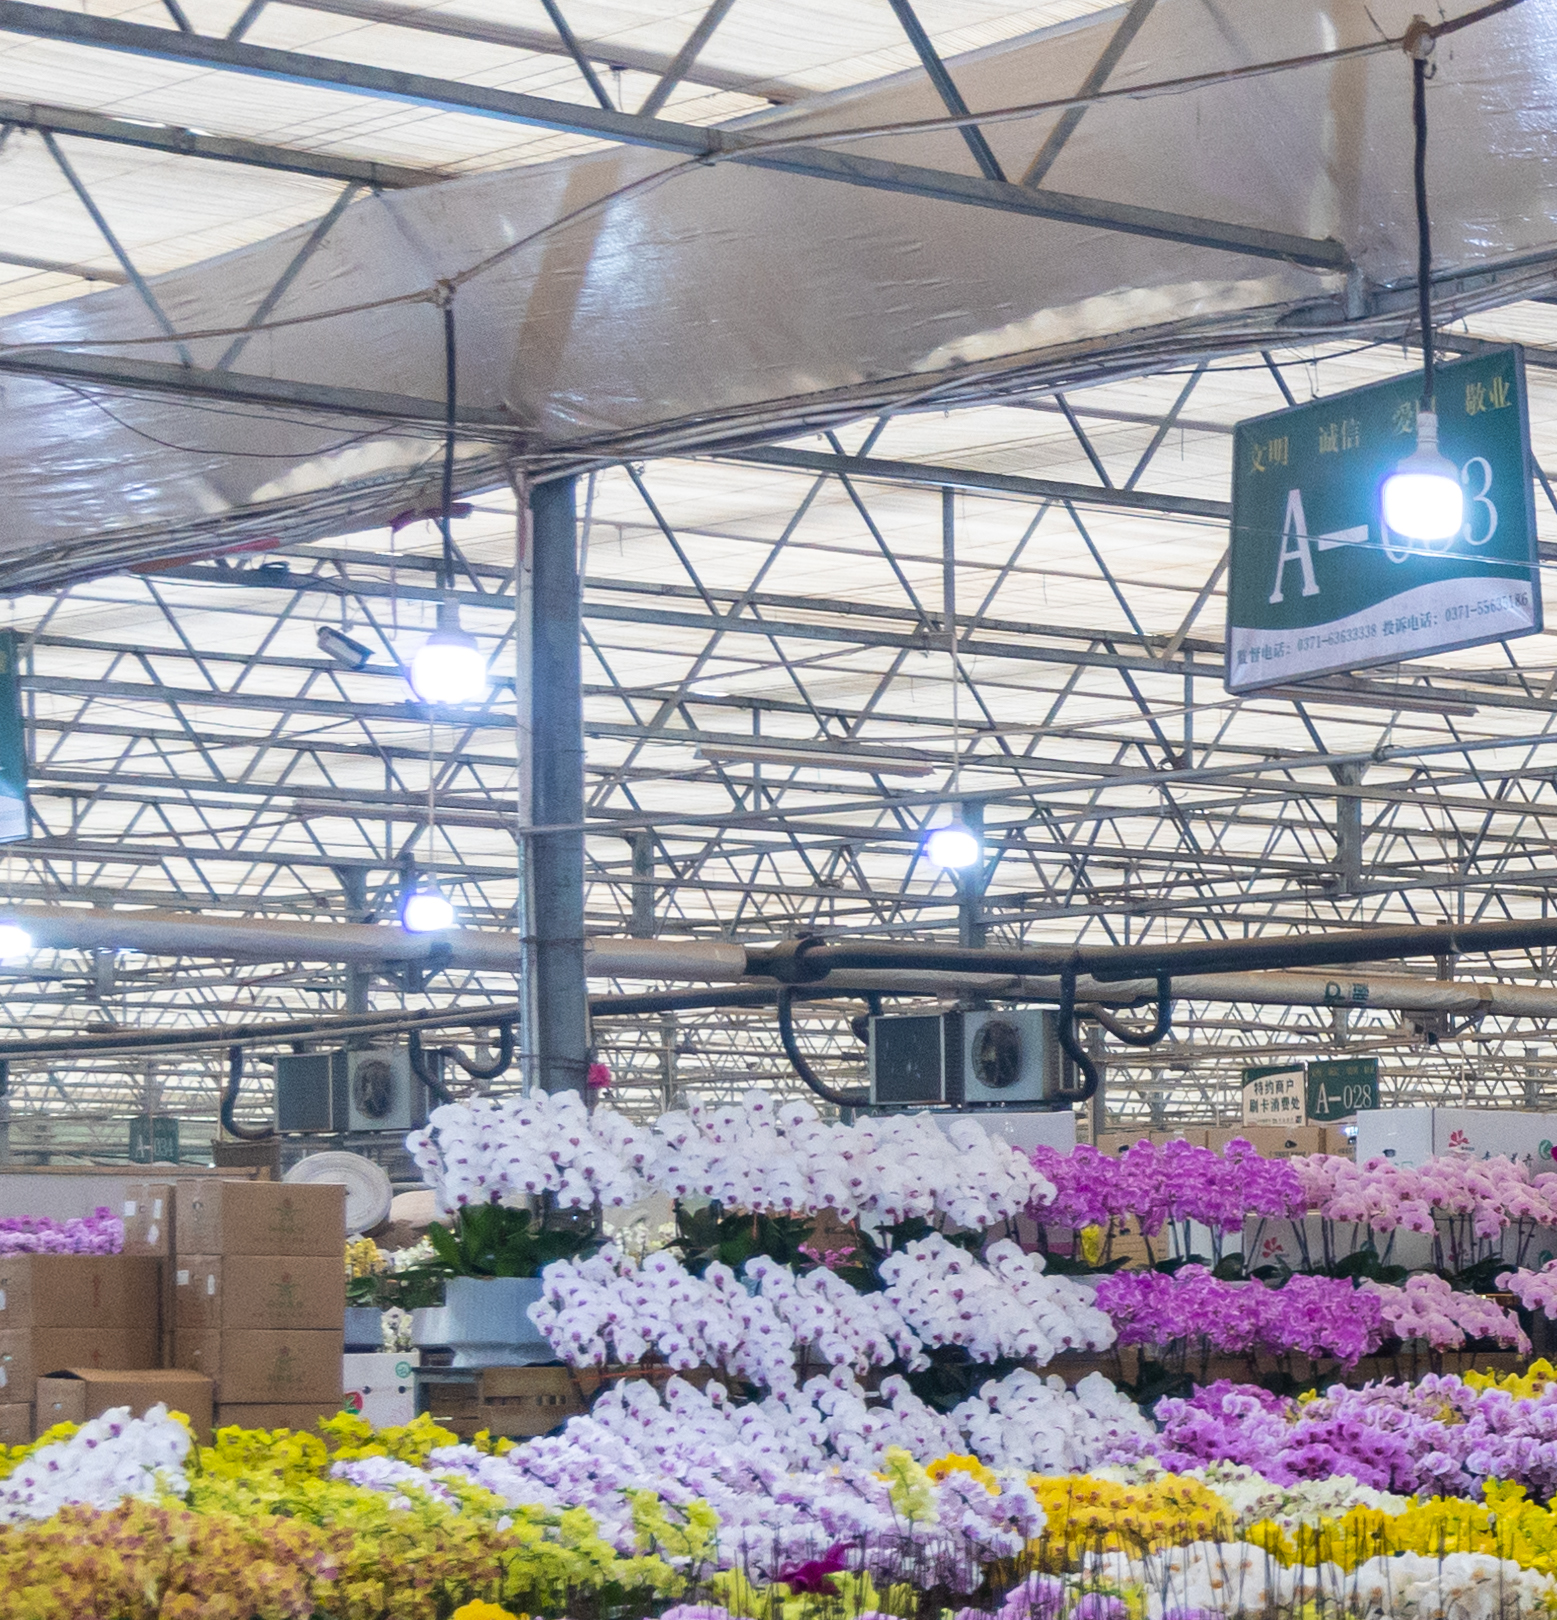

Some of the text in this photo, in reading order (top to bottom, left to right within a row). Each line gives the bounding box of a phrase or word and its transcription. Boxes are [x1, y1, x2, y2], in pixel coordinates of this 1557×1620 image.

[1250, 435, 1289, 472] 文明
[1319, 417, 1360, 454] 诚信
[1465, 375, 1512, 417] 敬业
[1269, 456, 1498, 604] A-3
[1253, 1078, 1294, 1096] 特约商户
[1315, 1082, 1372, 1114] A-028
[1249, 1096, 1300, 1113] 刷卡消费处
